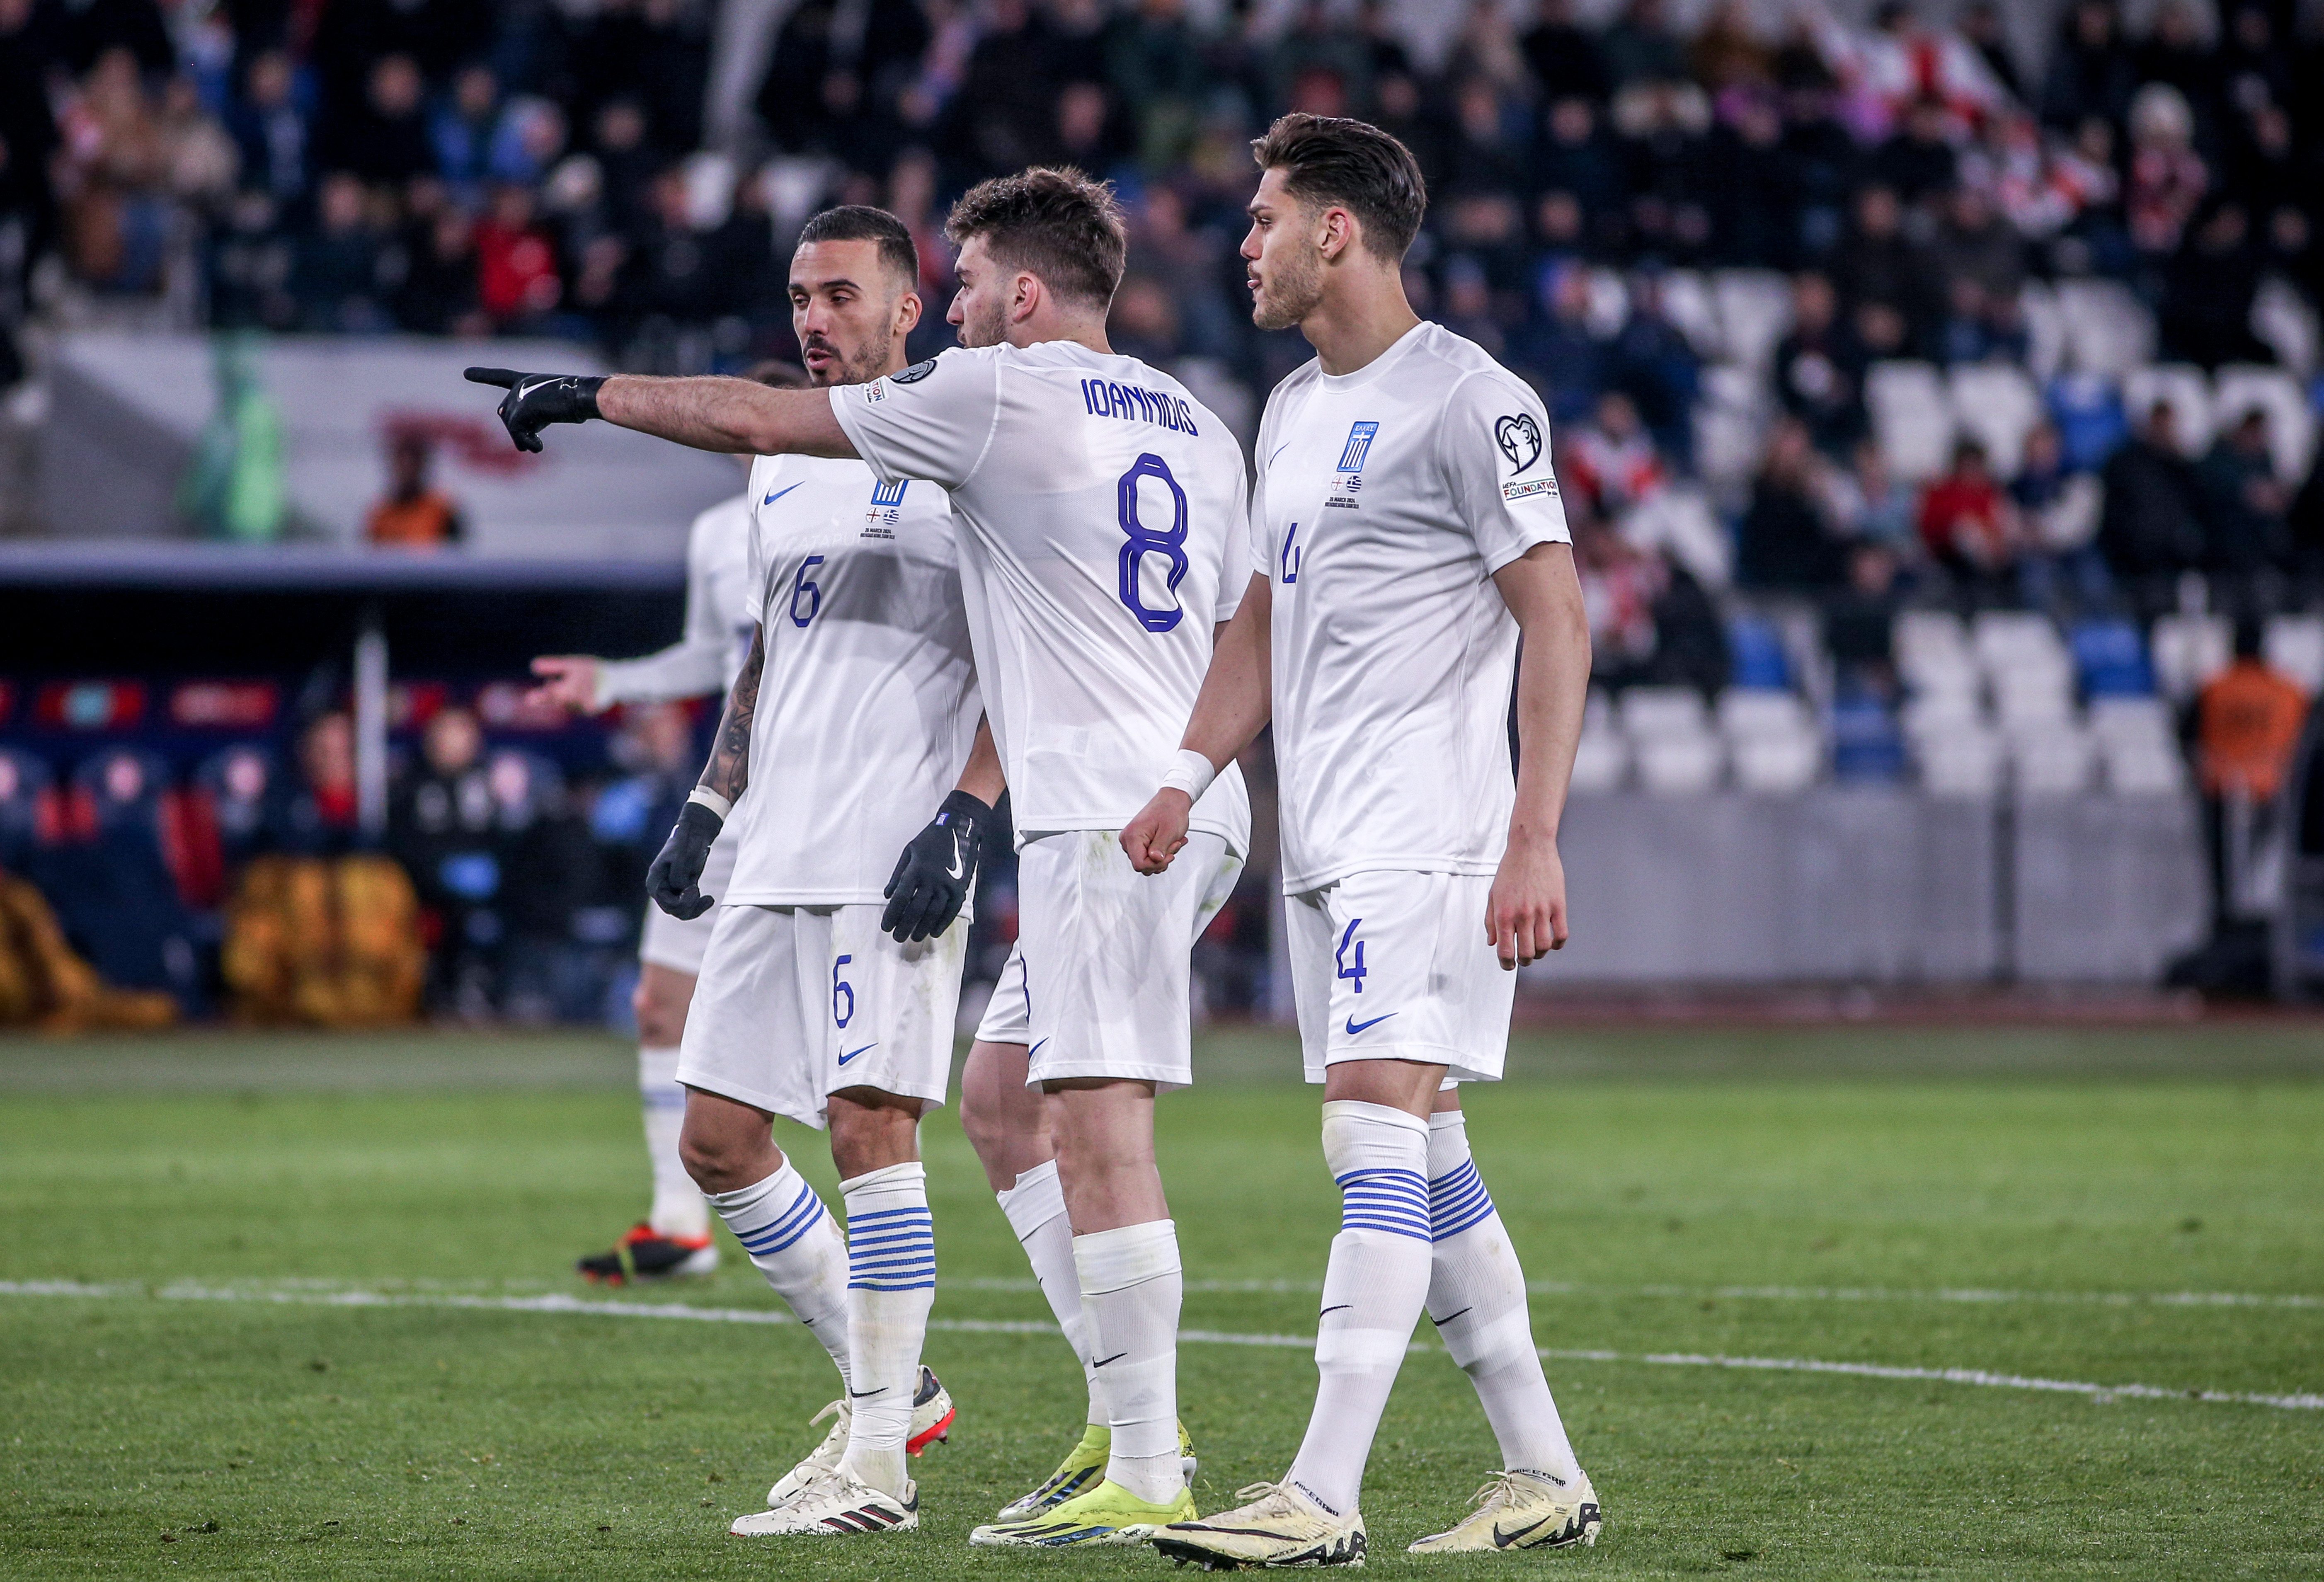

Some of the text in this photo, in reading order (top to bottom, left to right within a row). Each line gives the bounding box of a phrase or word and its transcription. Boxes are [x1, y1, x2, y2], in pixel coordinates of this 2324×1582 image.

[1081, 379, 1199, 436] IOANNIDIS
[1118, 452, 1189, 632] 8
[790, 555, 825, 627] 6
[833, 954, 854, 1029] 6
[1336, 918, 1367, 993] 4
